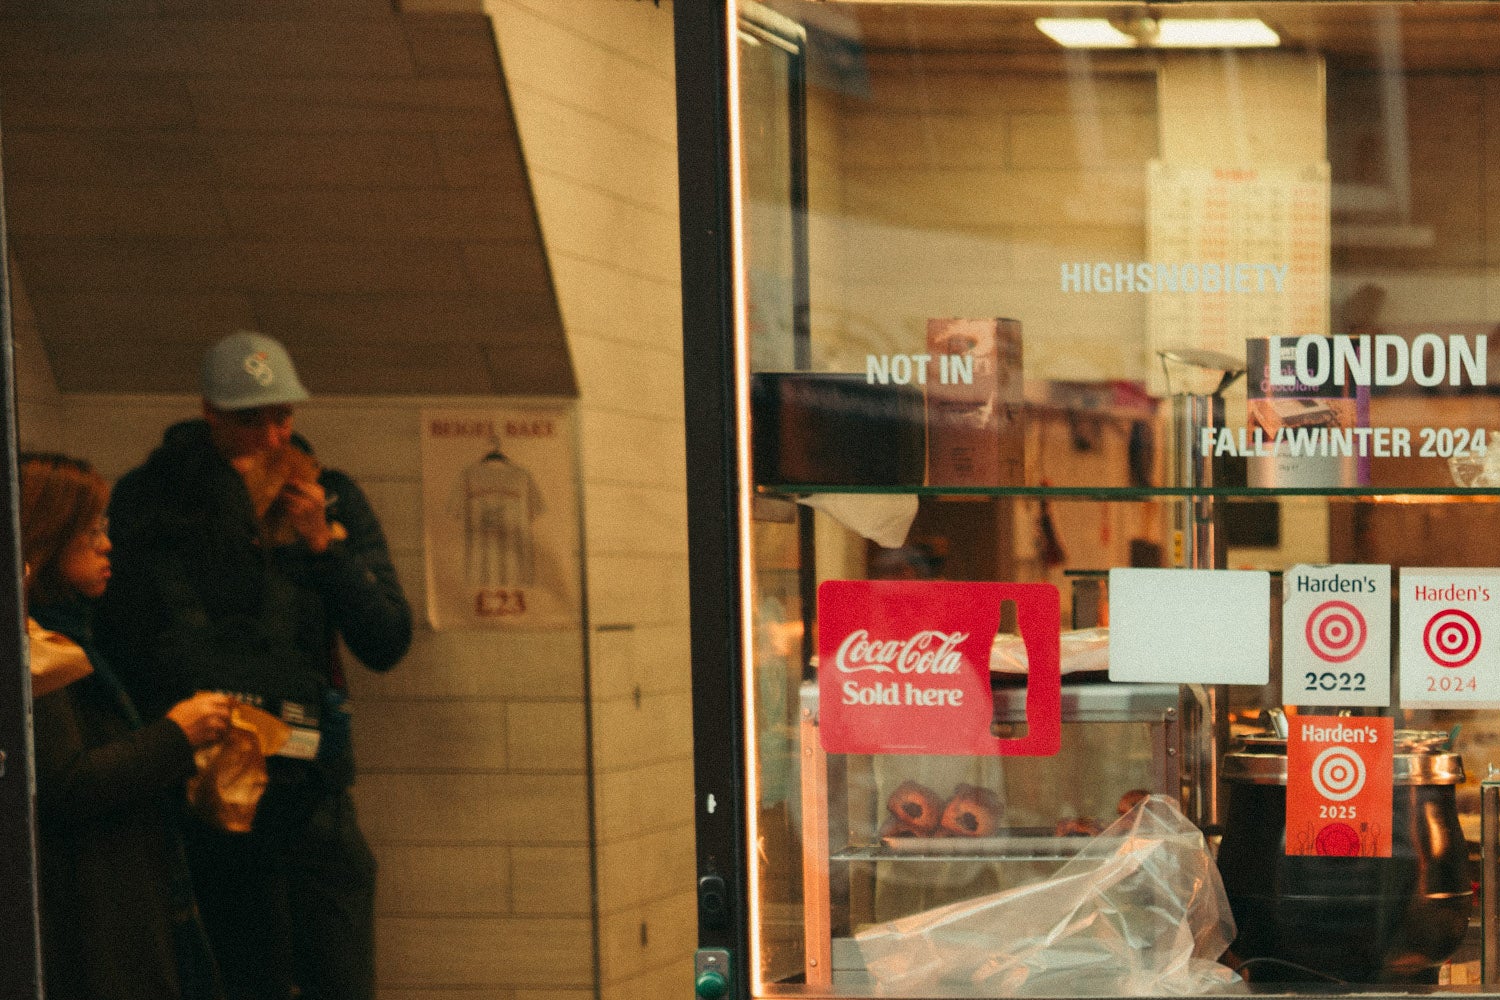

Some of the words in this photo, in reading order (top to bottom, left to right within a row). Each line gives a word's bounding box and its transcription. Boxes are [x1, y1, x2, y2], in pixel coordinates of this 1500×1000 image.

[1061, 262, 1288, 293] HIGHSNOBIETY
[865, 354, 932, 385] NOT
[939, 354, 974, 385] IN
[1268, 334, 1488, 387] LONDON
[1201, 427, 1412, 458] FALL/WINTER
[1419, 427, 1488, 458] 2024
[1297, 573, 1376, 593] Harden's
[1415, 583, 1490, 603] Harden's
[1304, 671, 1366, 692] 2022
[1426, 675, 1477, 693] 2024
[842, 680, 901, 706] Sold
[904, 682, 964, 707] here
[1301, 723, 1378, 743] Harden's
[1318, 804, 1357, 820] 2025
